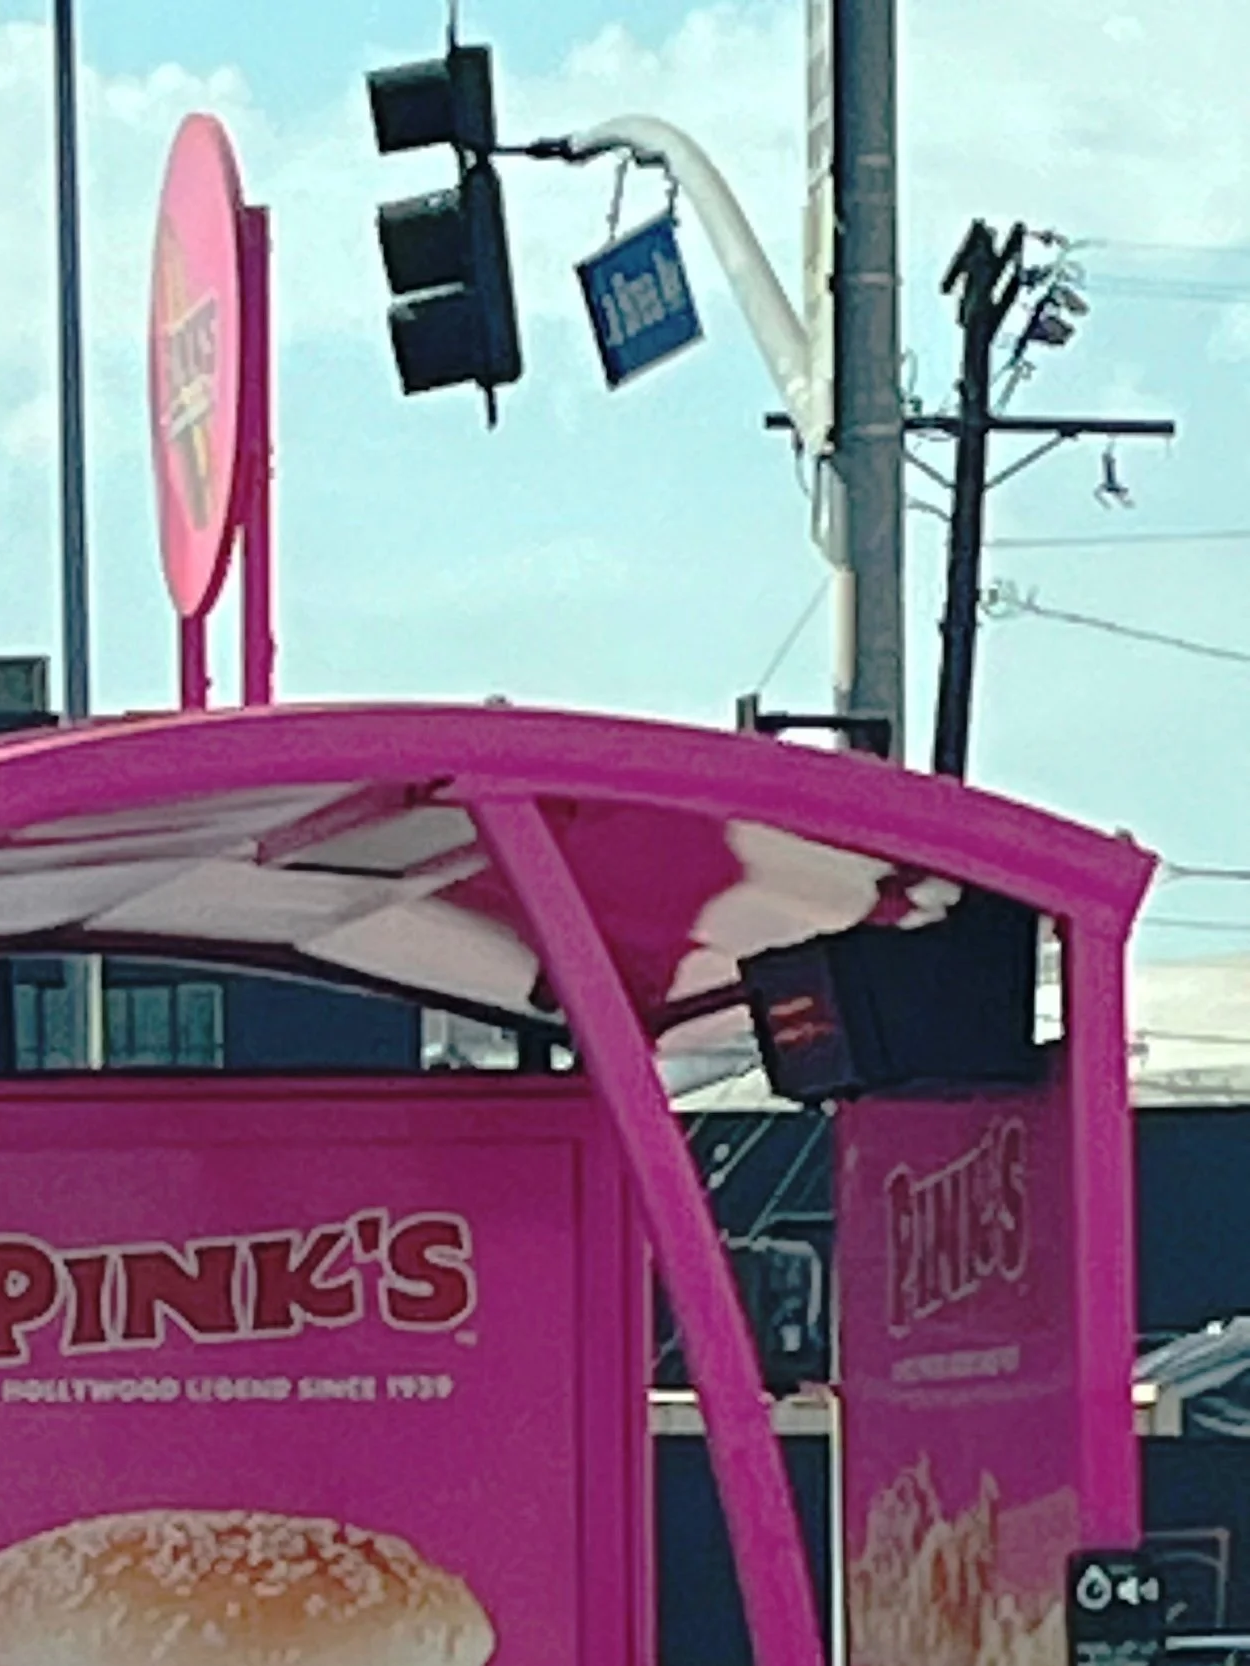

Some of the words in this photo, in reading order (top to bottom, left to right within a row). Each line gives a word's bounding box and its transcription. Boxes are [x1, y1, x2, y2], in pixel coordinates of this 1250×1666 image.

[1, 1376, 181, 1403] HOLLYWOOD
[185, 1375, 292, 1401] LEGEND
[297, 1375, 378, 1400] SINCE
[386, 1374, 455, 1400] 1939
